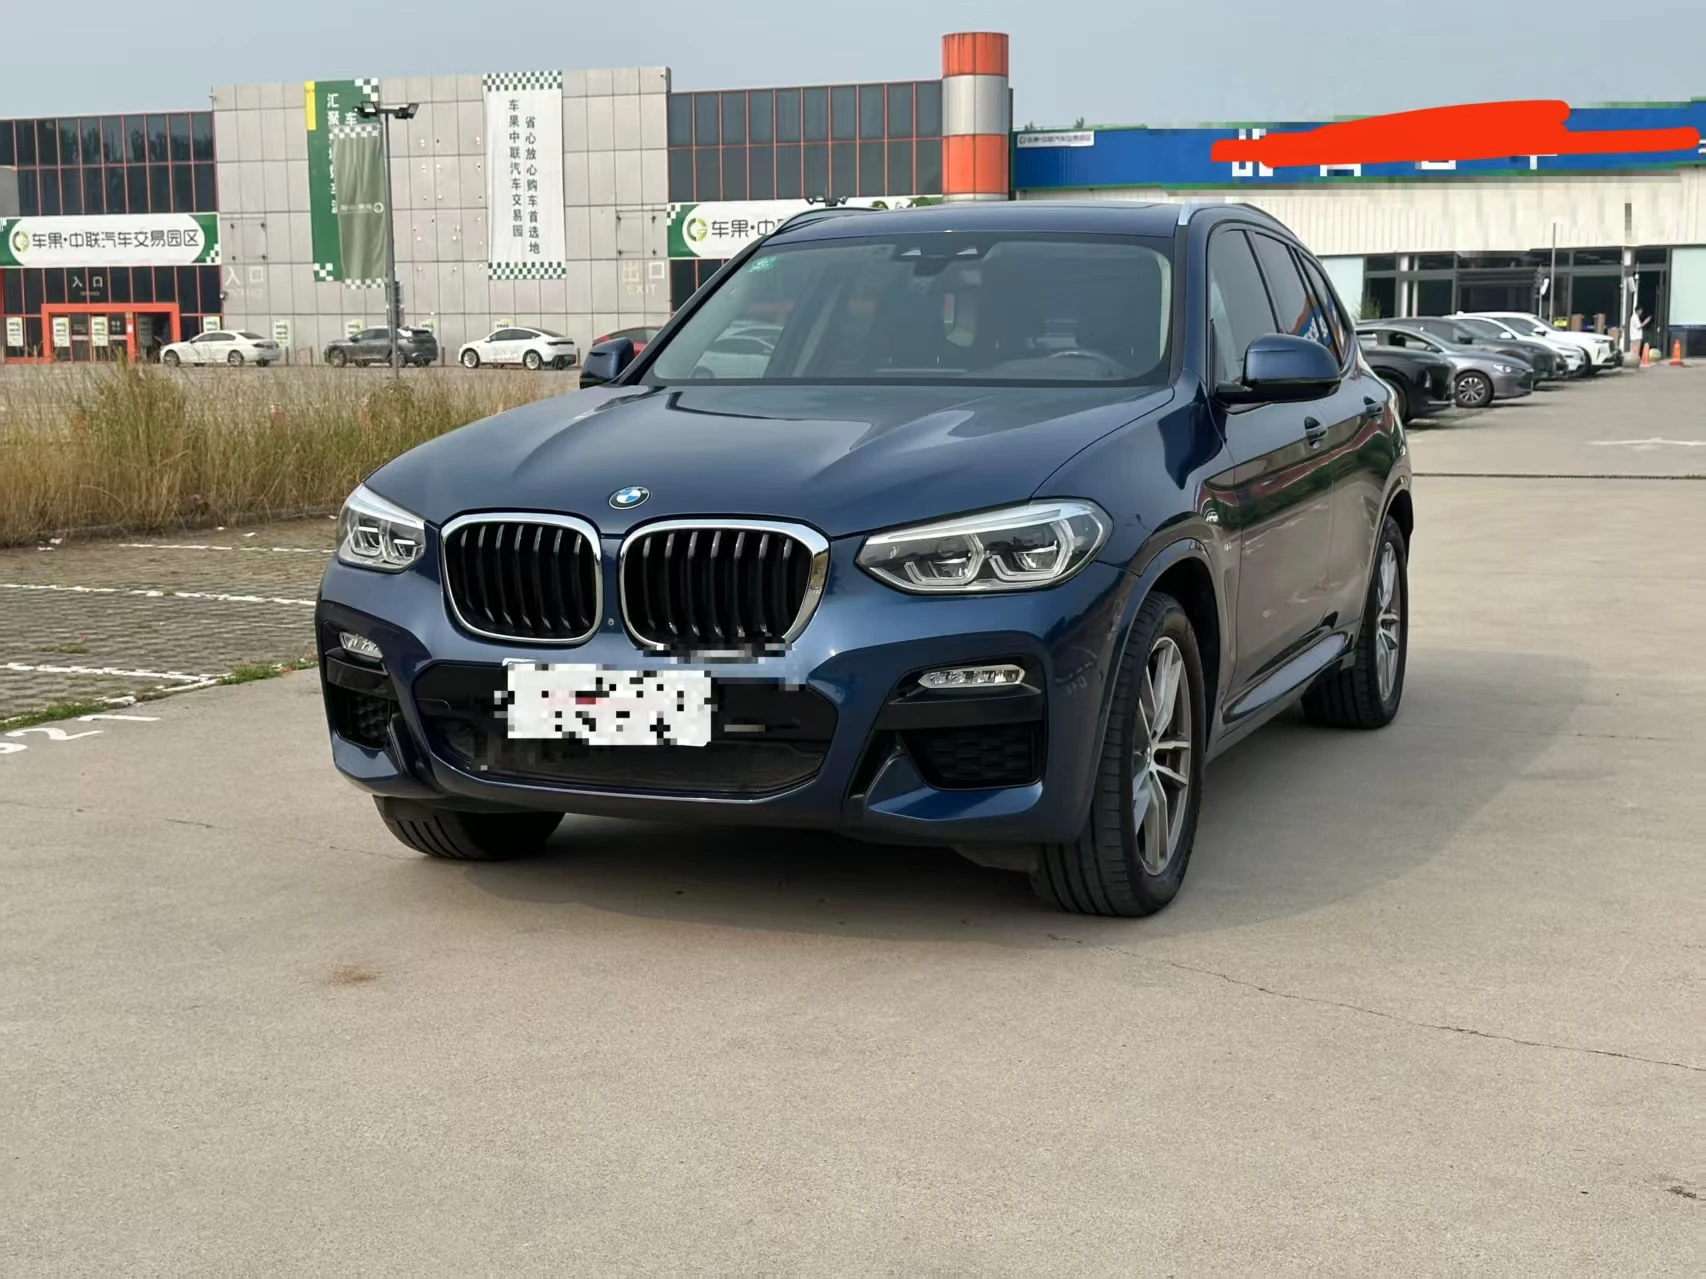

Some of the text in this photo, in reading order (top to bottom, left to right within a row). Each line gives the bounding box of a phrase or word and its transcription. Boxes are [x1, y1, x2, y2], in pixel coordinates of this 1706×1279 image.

[508, 99, 523, 237] 车果中联汽车交易园
[525, 116, 540, 254] 省心放心购车首选地
[32, 229, 200, 249] 车果·中联汽车交易园区
[72, 275, 103, 288] 入口
